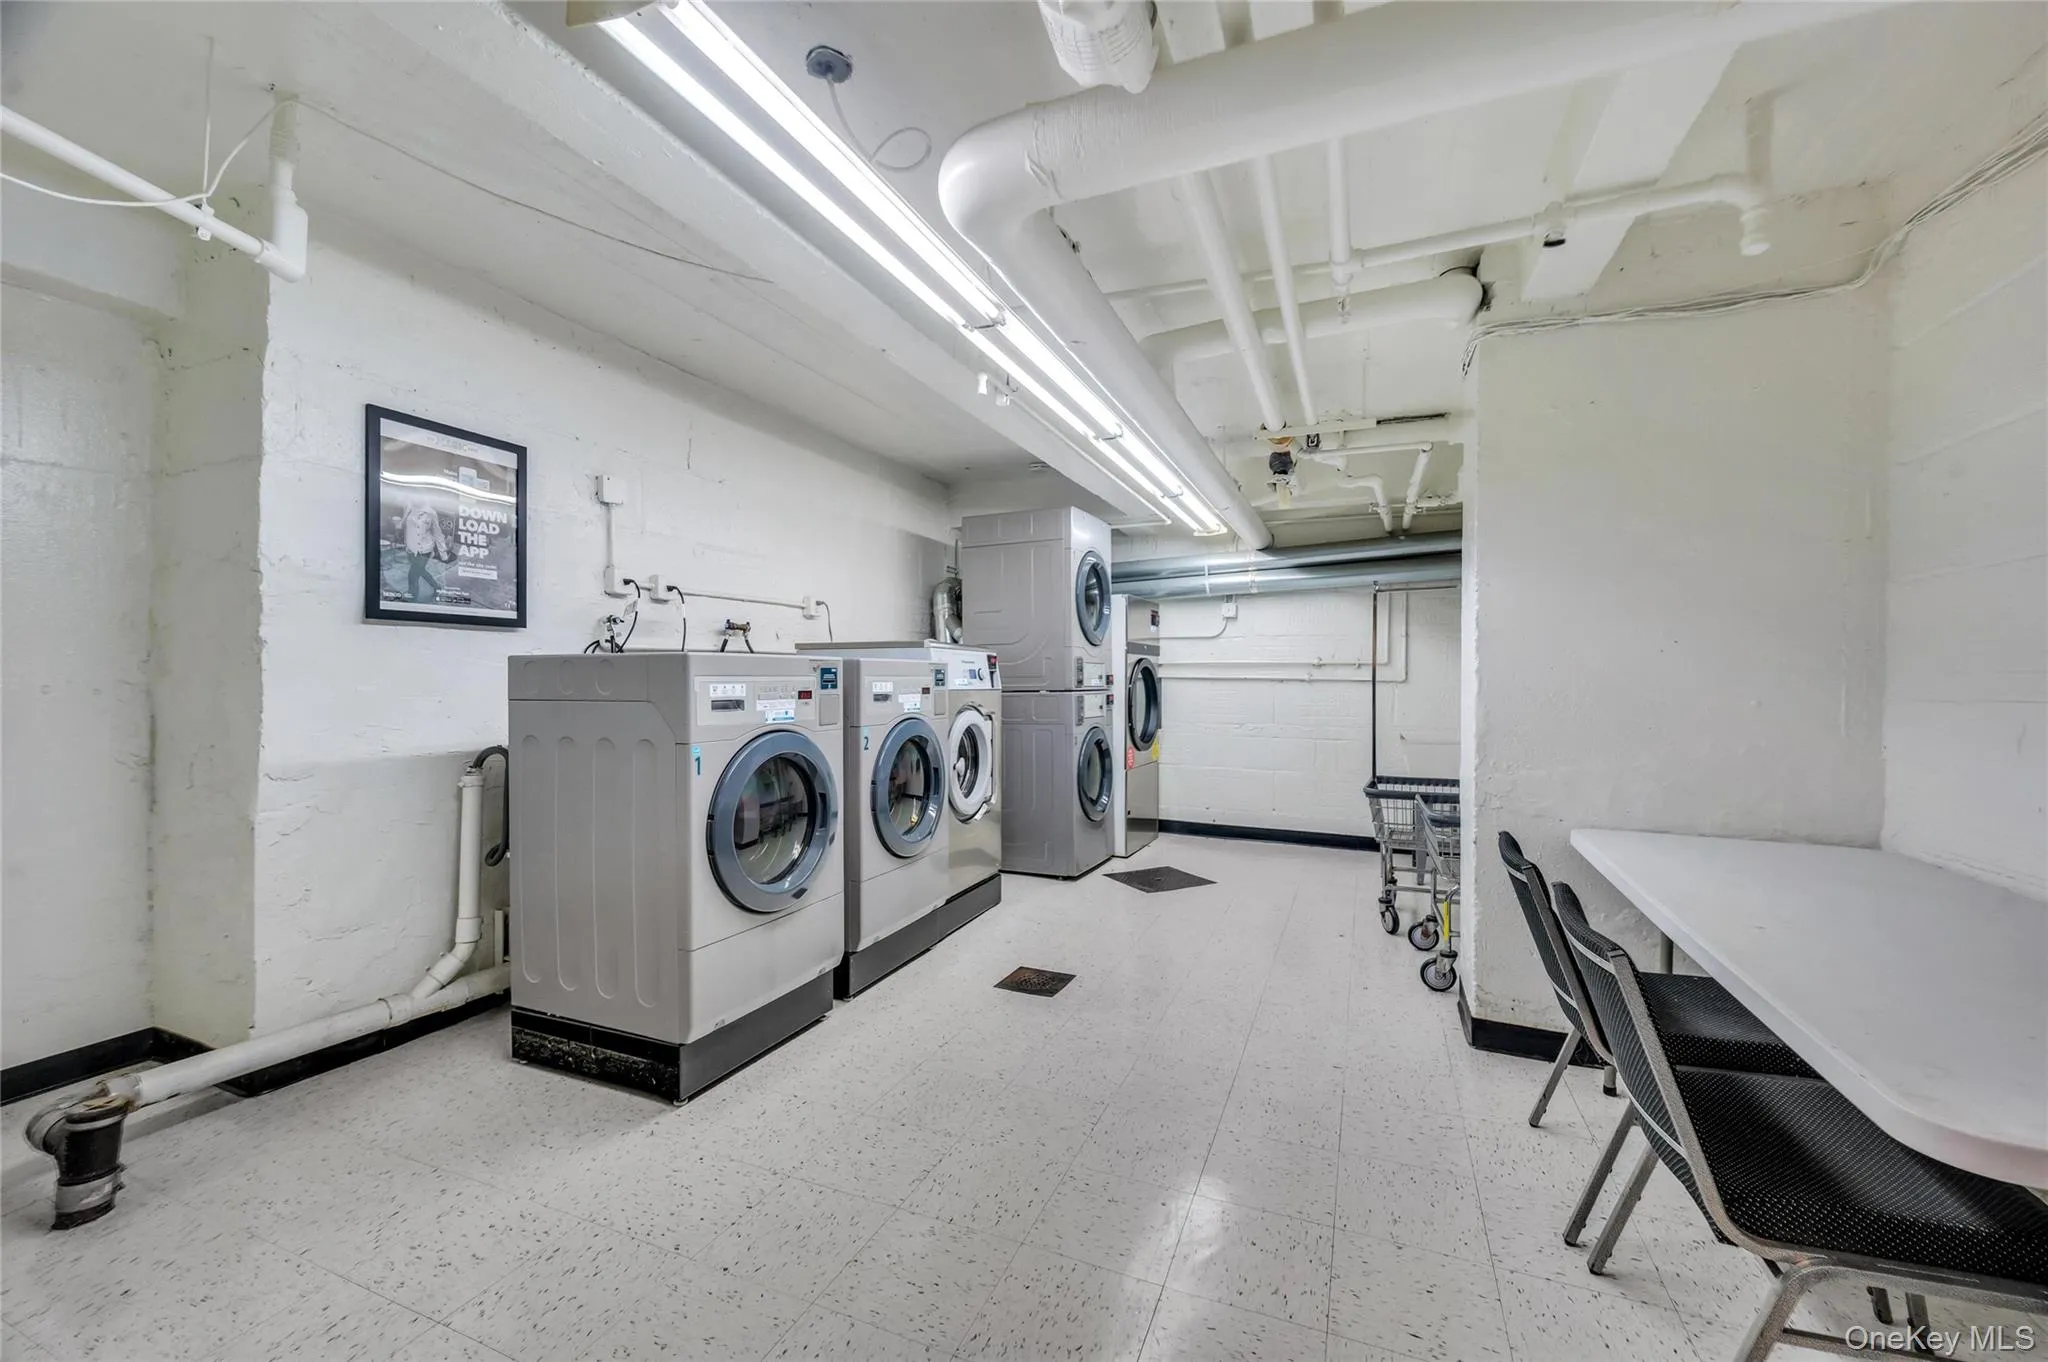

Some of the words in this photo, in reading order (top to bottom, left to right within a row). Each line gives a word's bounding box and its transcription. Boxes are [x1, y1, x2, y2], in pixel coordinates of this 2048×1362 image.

[458, 505, 508, 524] DOWN
[458, 518, 500, 535] LOAD
[457, 531, 487, 546] THE
[458, 545, 489, 559] APP
[863, 736, 870, 751] 2
[694, 756, 701, 776] 1
